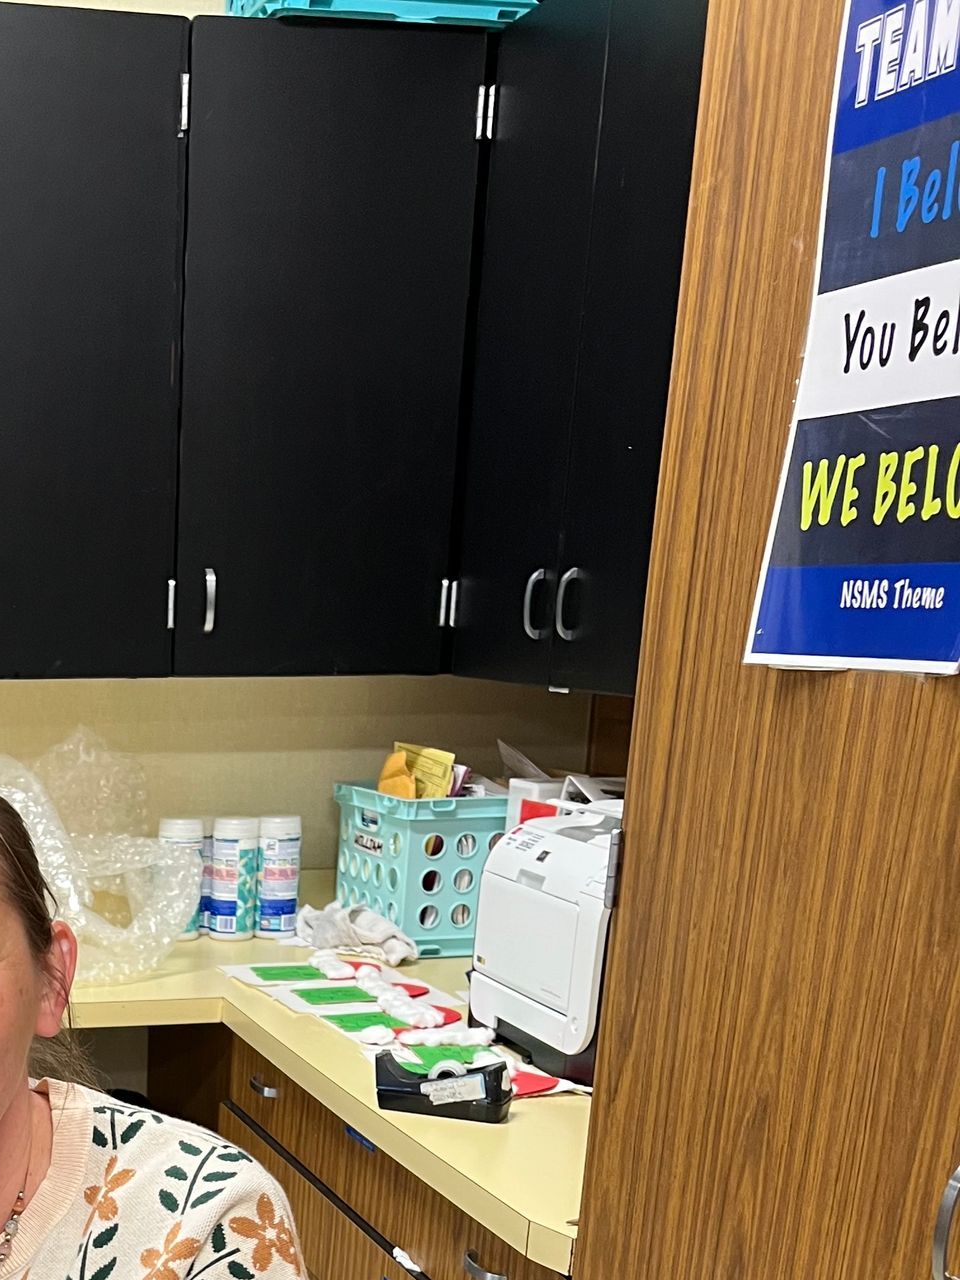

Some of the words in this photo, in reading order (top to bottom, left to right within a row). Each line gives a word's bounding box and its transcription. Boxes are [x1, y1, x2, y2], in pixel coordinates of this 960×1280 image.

[855, 0, 957, 109] TEAM
[869, 166, 887, 239] I
[896, 140, 960, 234] Bel
[843, 309, 896, 374] You
[800, 454, 866, 532] WE
[839, 578, 889, 610] NSMS
[893, 578, 945, 610] Theme
